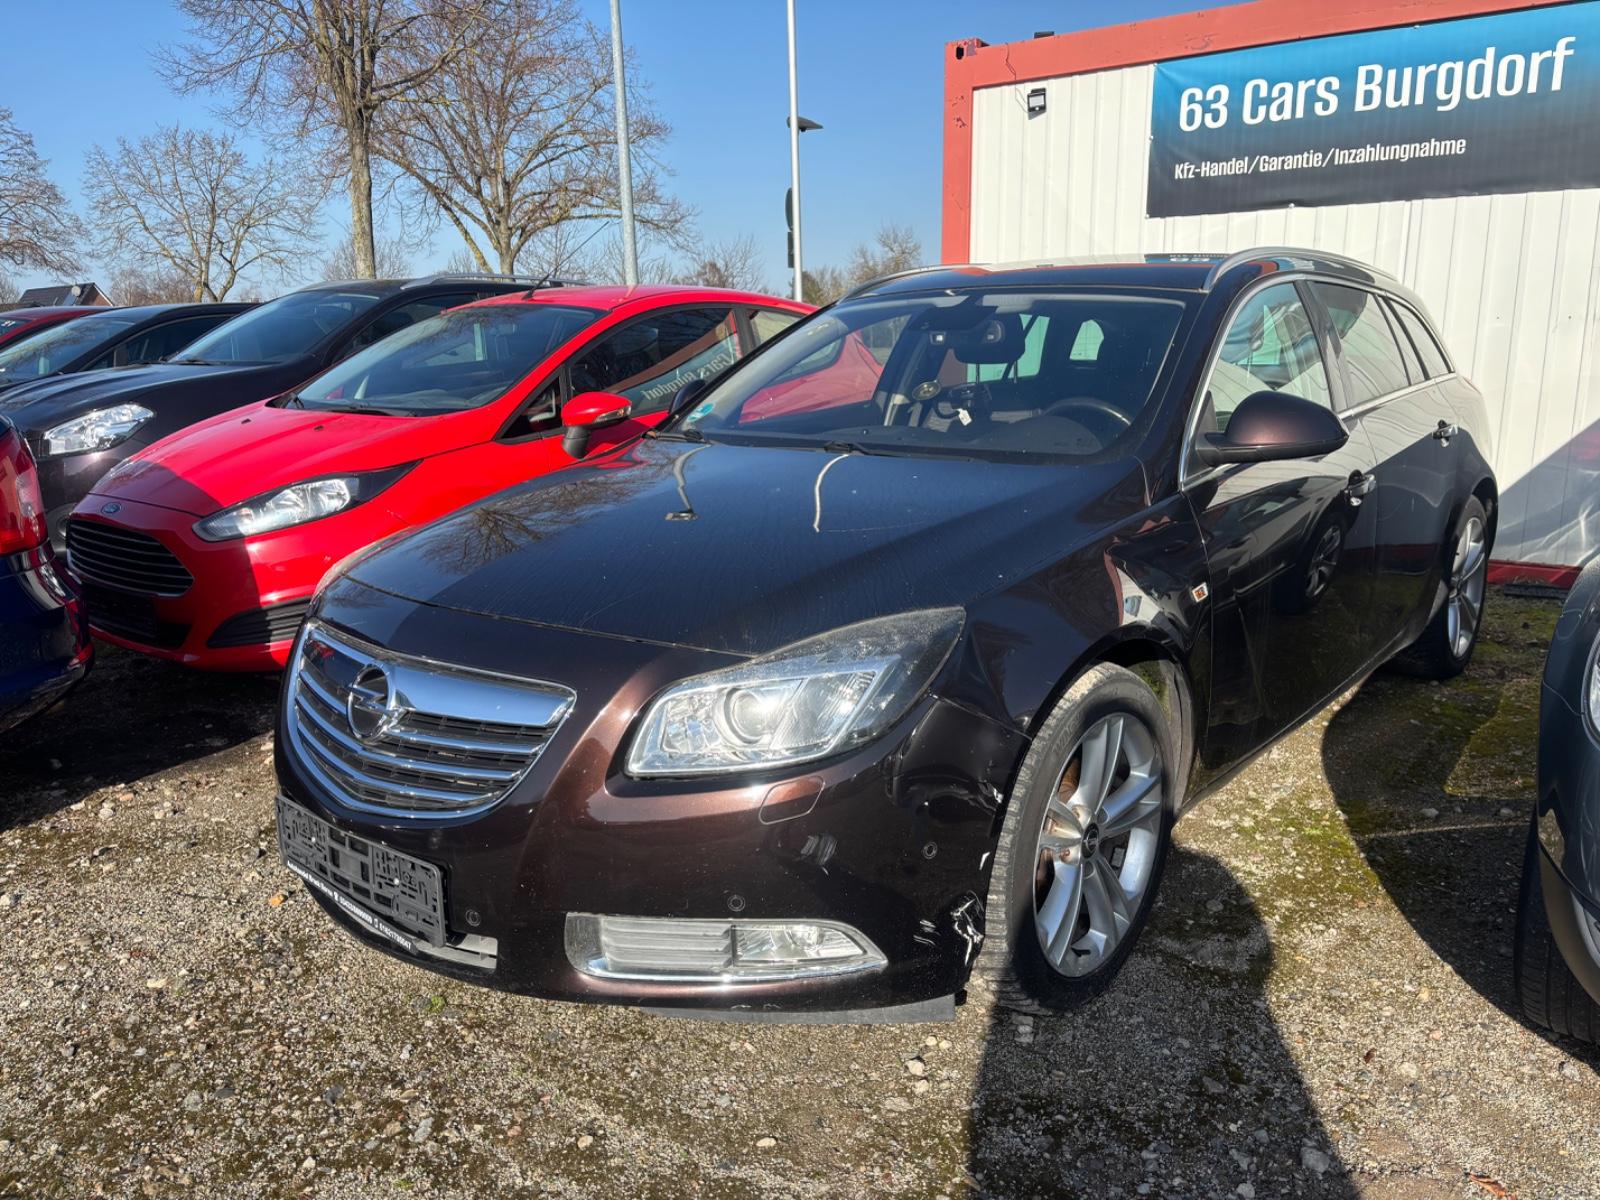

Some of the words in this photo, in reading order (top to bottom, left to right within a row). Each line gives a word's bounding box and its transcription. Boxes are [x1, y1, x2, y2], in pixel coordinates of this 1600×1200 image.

[1179, 84, 1229, 131] 63
[1242, 76, 1339, 124] Cars
[1354, 36, 1576, 112] Burgdorf
